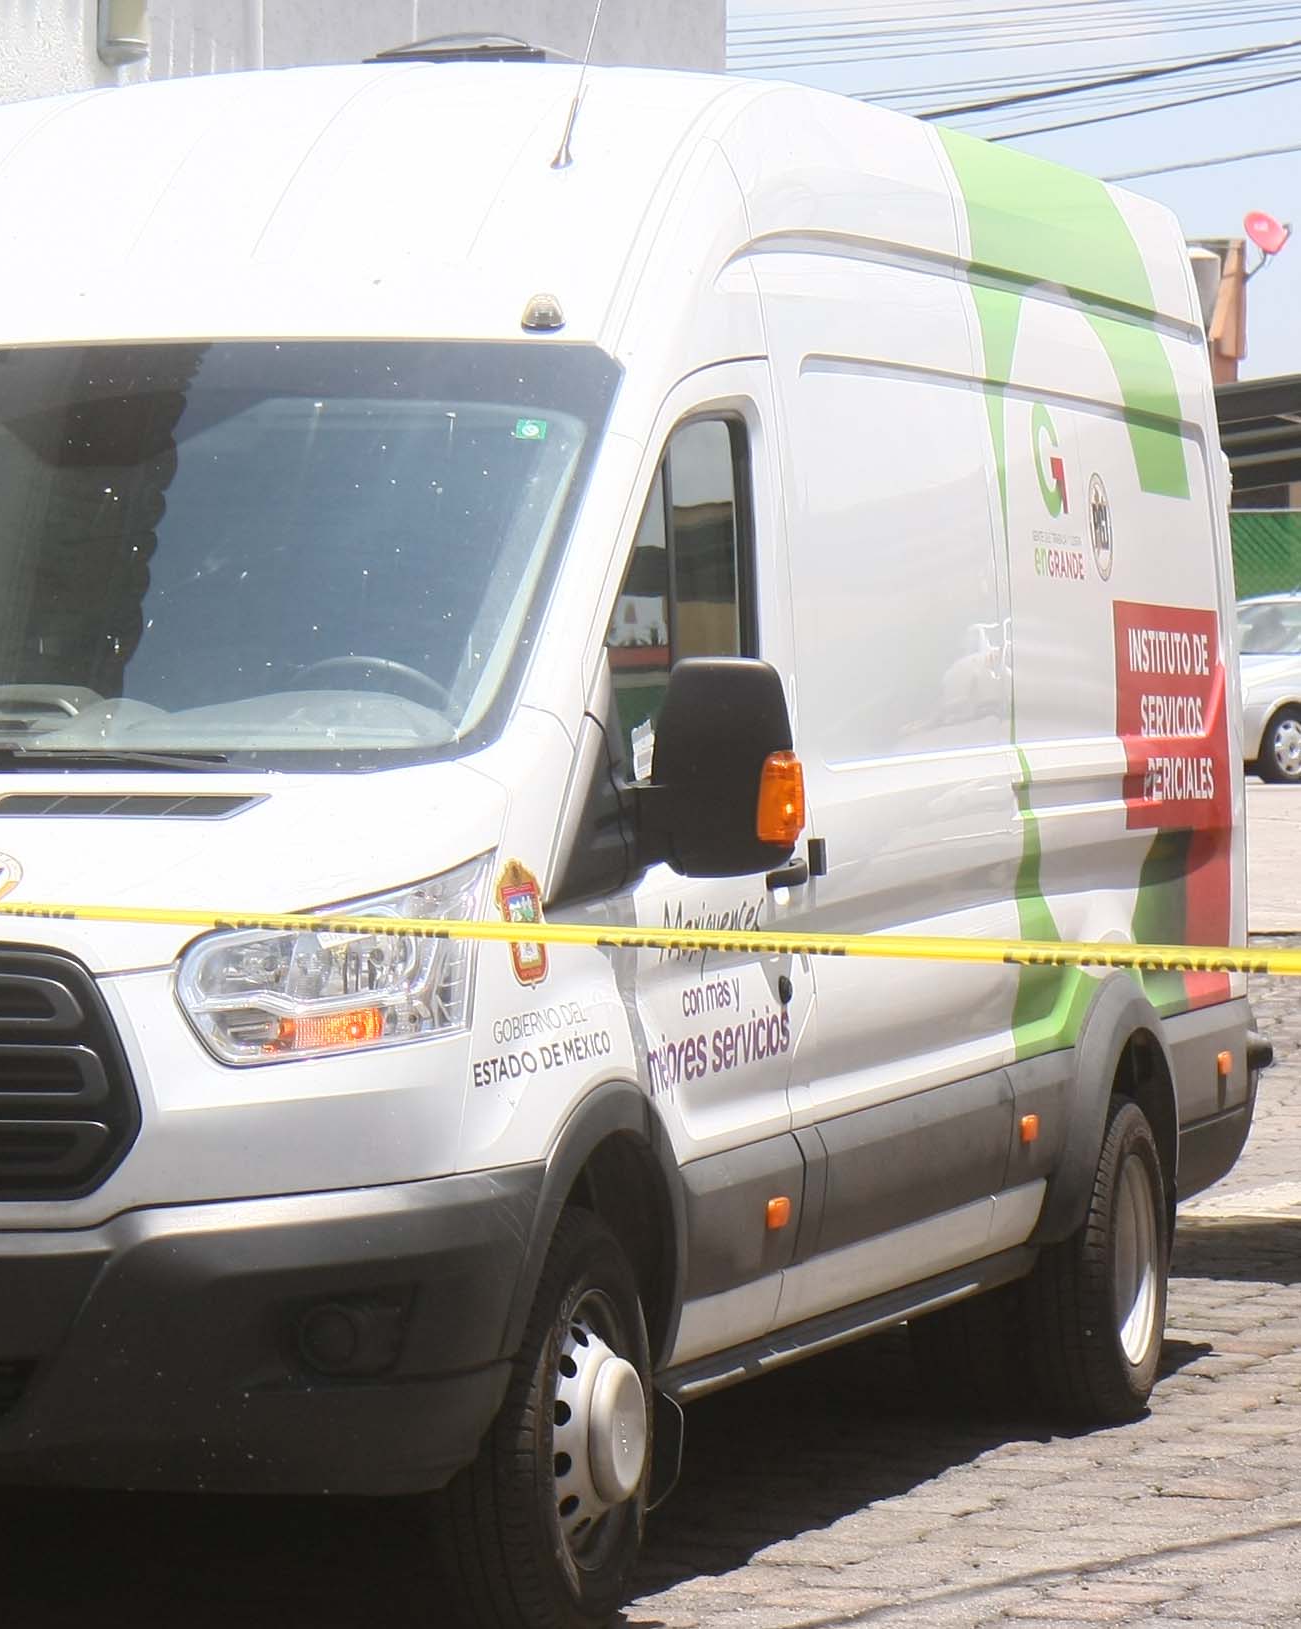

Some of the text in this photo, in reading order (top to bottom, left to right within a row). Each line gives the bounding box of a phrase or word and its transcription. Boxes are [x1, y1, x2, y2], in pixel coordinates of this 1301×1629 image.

[1128, 628, 1210, 676] INSTITUTO DE
[1140, 694, 1205, 738] SERVICIOS
[1143, 757, 1215, 802] PERICIALES
[682, 974, 740, 1017] con más y
[493, 1002, 588, 1044] GOBIERNO DEL
[473, 1031, 611, 1087] ESTADO DE MÉXICO
[647, 1005, 790, 1104] mejores servicios
